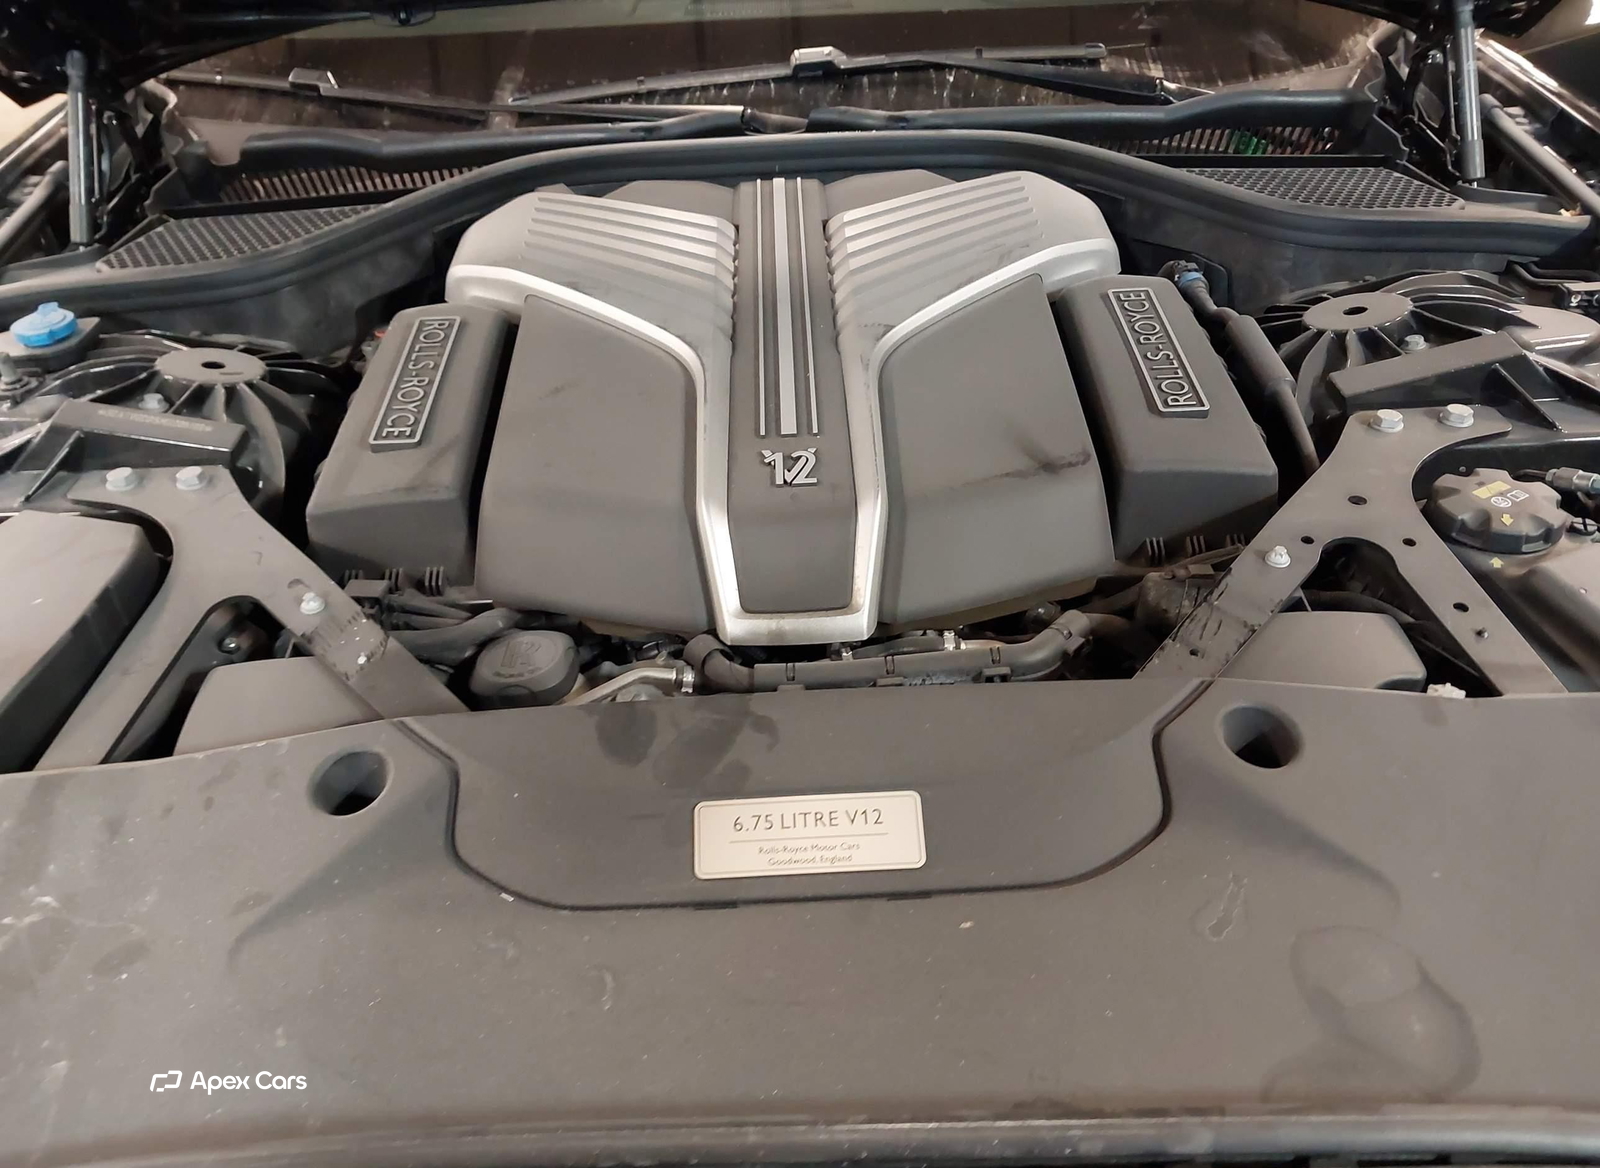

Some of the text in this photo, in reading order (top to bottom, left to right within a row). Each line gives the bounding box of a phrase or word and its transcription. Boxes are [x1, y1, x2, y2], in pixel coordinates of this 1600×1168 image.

[1119, 291, 1197, 406] ROLLS-ROYCE
[381, 320, 450, 438] ROLLS-ROYCE
[733, 808, 884, 832] 6.75 LITRE V12
[758, 842, 860, 855] Rolls-Royce Motor Cars
[820, 854, 853, 865] England
